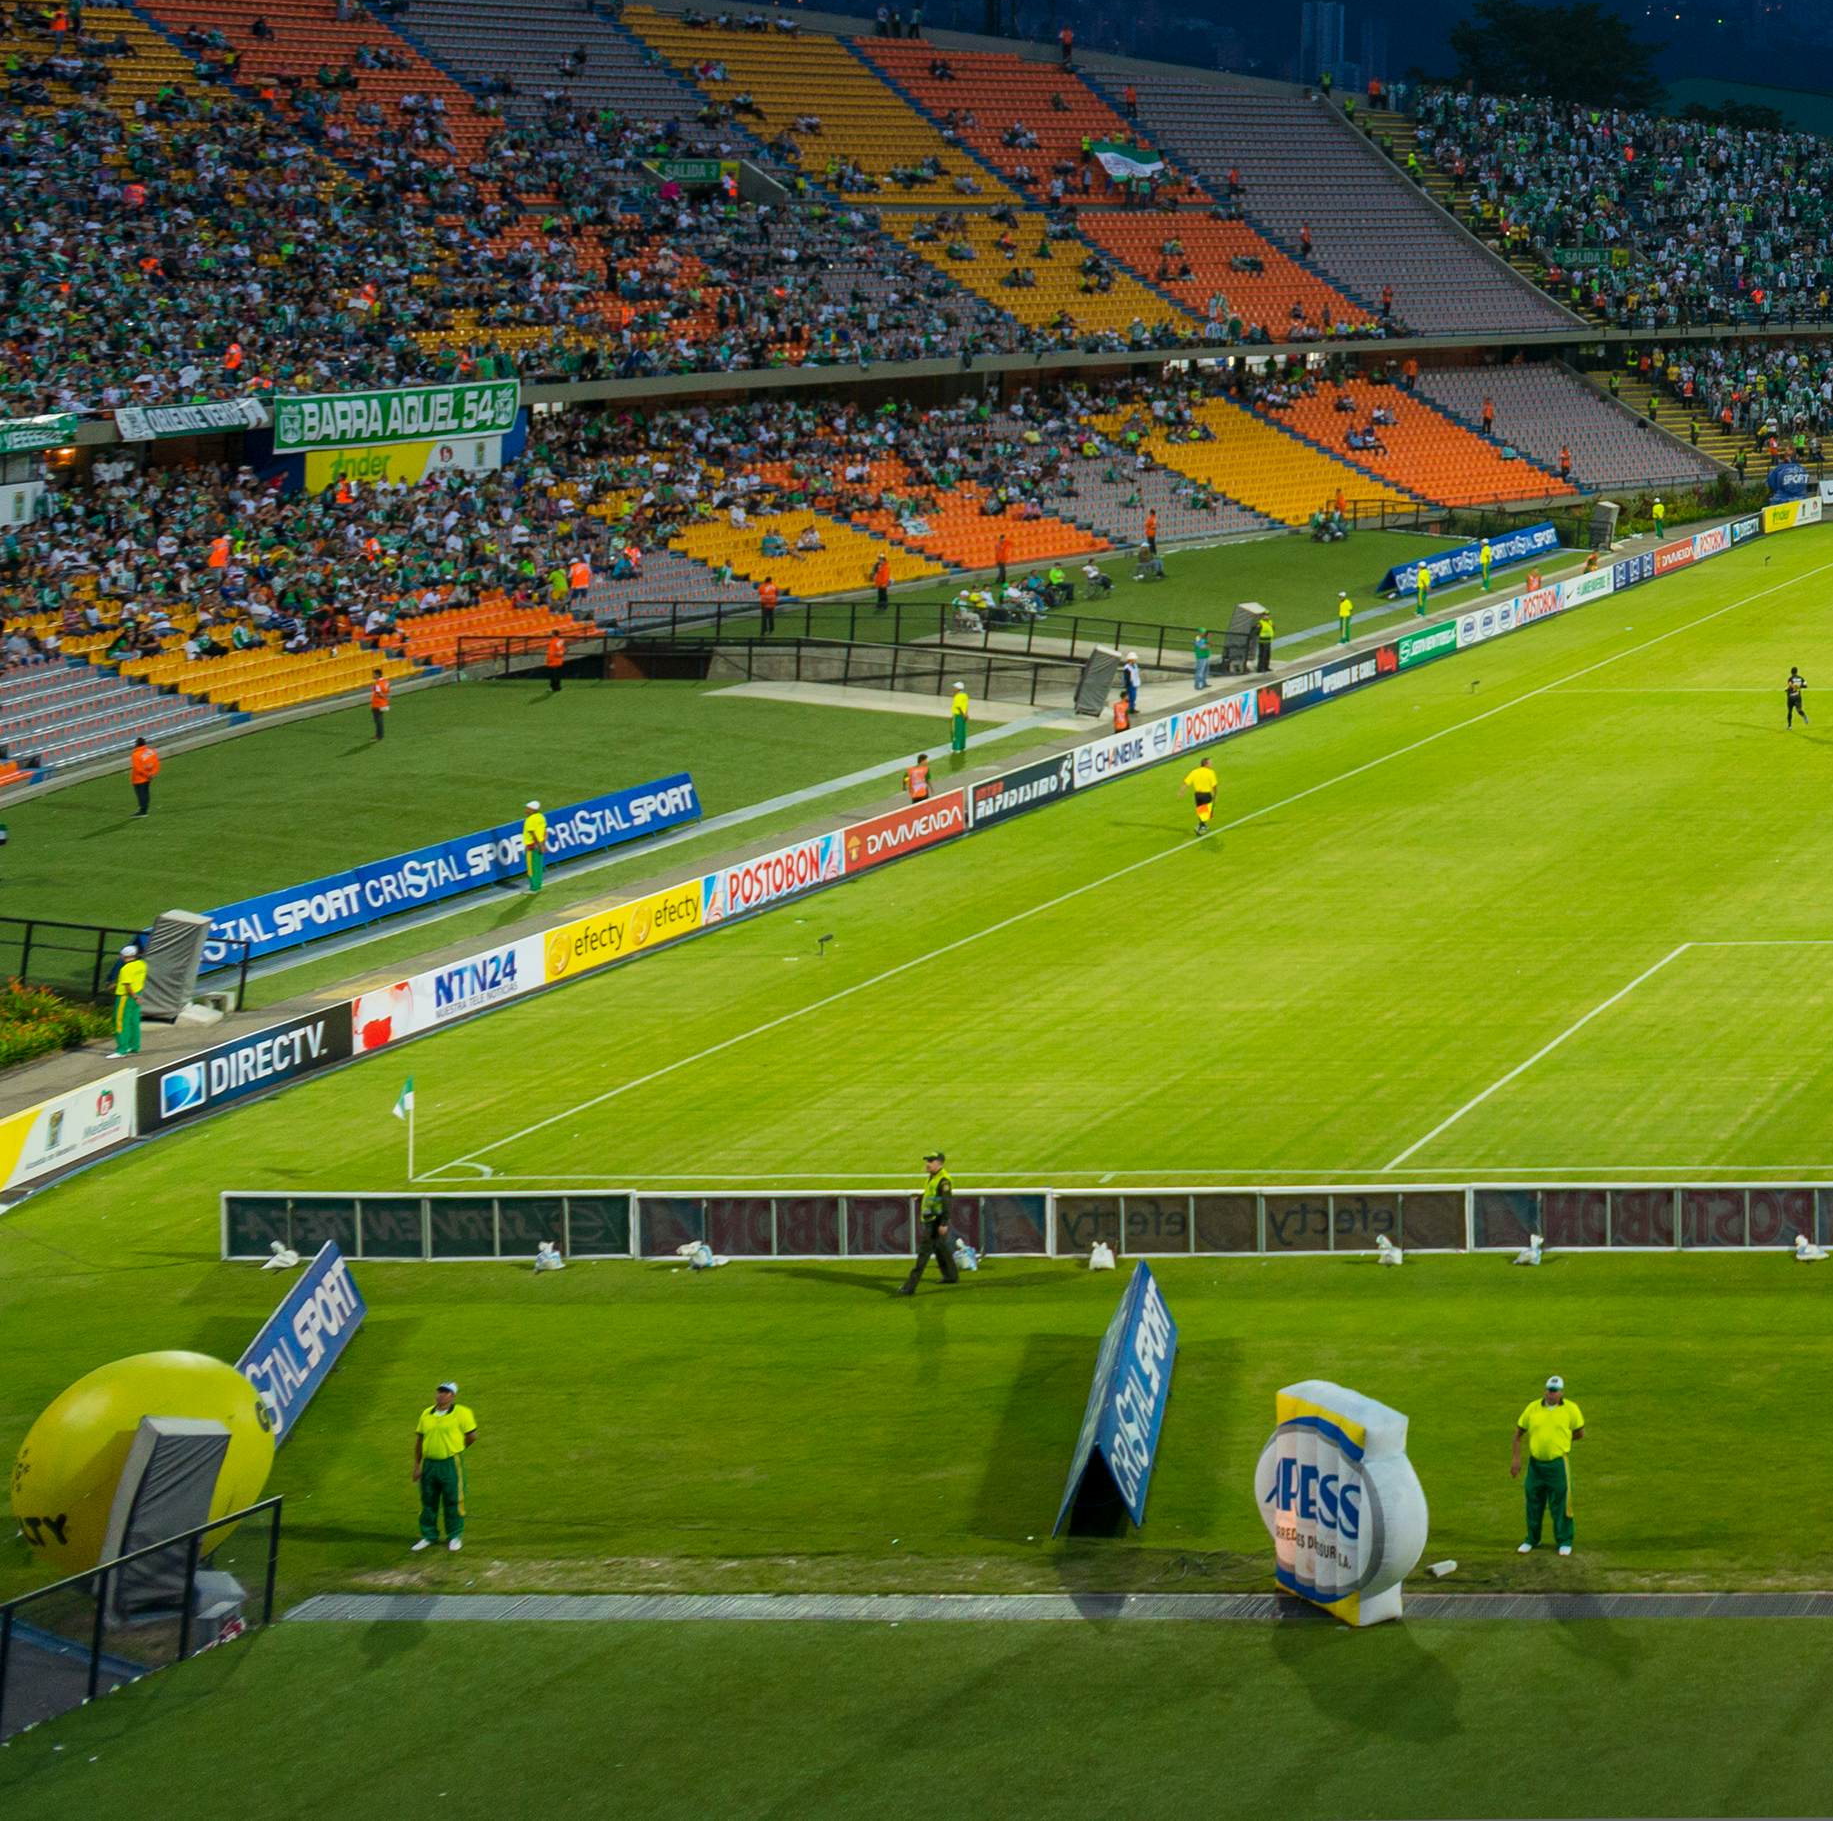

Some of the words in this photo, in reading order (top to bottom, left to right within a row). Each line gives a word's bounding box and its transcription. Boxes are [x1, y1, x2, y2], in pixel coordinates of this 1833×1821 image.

[147, 404, 207, 433] ORIENTE
[302, 398, 383, 442] BARRA
[462, 389, 495, 428] 54
[1522, 588, 1558, 617] POSTOBON
[1186, 697, 1243, 745] POSTOBON
[1096, 737, 1144, 773] CHANEME
[544, 806, 631, 853] CRISTAL
[630, 782, 693, 826] SPORT
[976, 774, 1058, 820] RAPIDISIMO
[866, 806, 962, 856] DAVIVIENDA
[364, 860, 467, 909] CRISTAL
[728, 845, 821, 913] POSTOBON
[272, 883, 361, 937] SPORT
[574, 922, 625, 957] efecty
[654, 894, 701, 928] efecty
[434, 950, 518, 1009] NTN24
[210, 1020, 325, 1097] DIRECTV
[292, 1256, 359, 1371] SPORT
[1110, 1365, 1157, 1509] CRISTAL
[1134, 1274, 1171, 1396] SPORT
